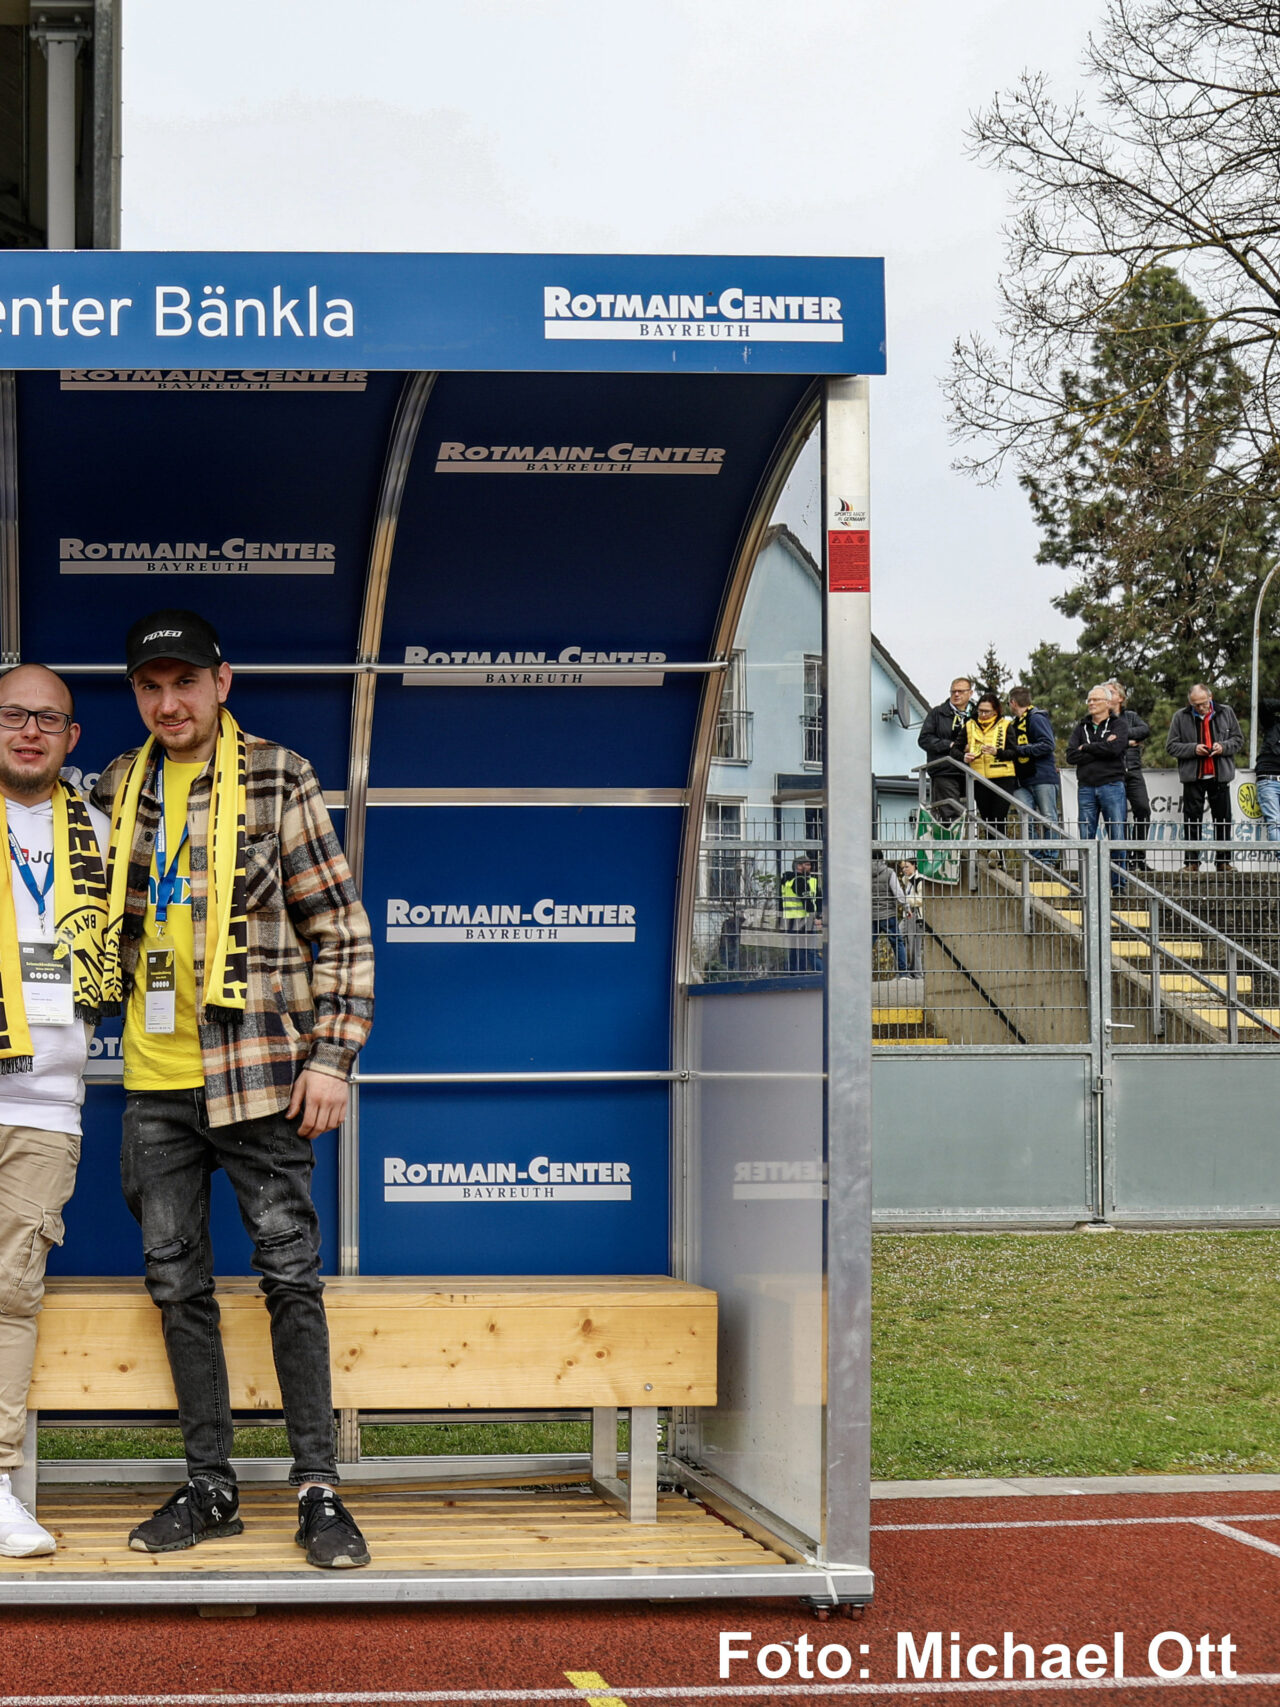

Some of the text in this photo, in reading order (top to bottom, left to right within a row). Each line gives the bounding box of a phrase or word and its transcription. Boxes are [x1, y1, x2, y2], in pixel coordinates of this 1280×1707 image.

[544, 287, 843, 320] ROTMAIN-CENTER
[155, 284, 355, 337] Bänkla
[640, 324, 750, 337] BAYREUTH
[157, 382, 272, 390] BAYREUTH
[437, 442, 726, 462] ROTMAIN-CENTER
[526, 463, 633, 472] BAYREUTH
[60, 537, 336, 560] ROTMAIN-CENTER
[147, 562, 250, 572] BAYREUTH
[485, 673, 584, 684] BAYREUTH
[387, 899, 636, 925] ROTMAIN-CENTER
[466, 929, 558, 940] BAYREUTH
[384, 1157, 631, 1184] ROTMAIN-CENTER
[463, 1187, 554, 1198] BAYREUTH
